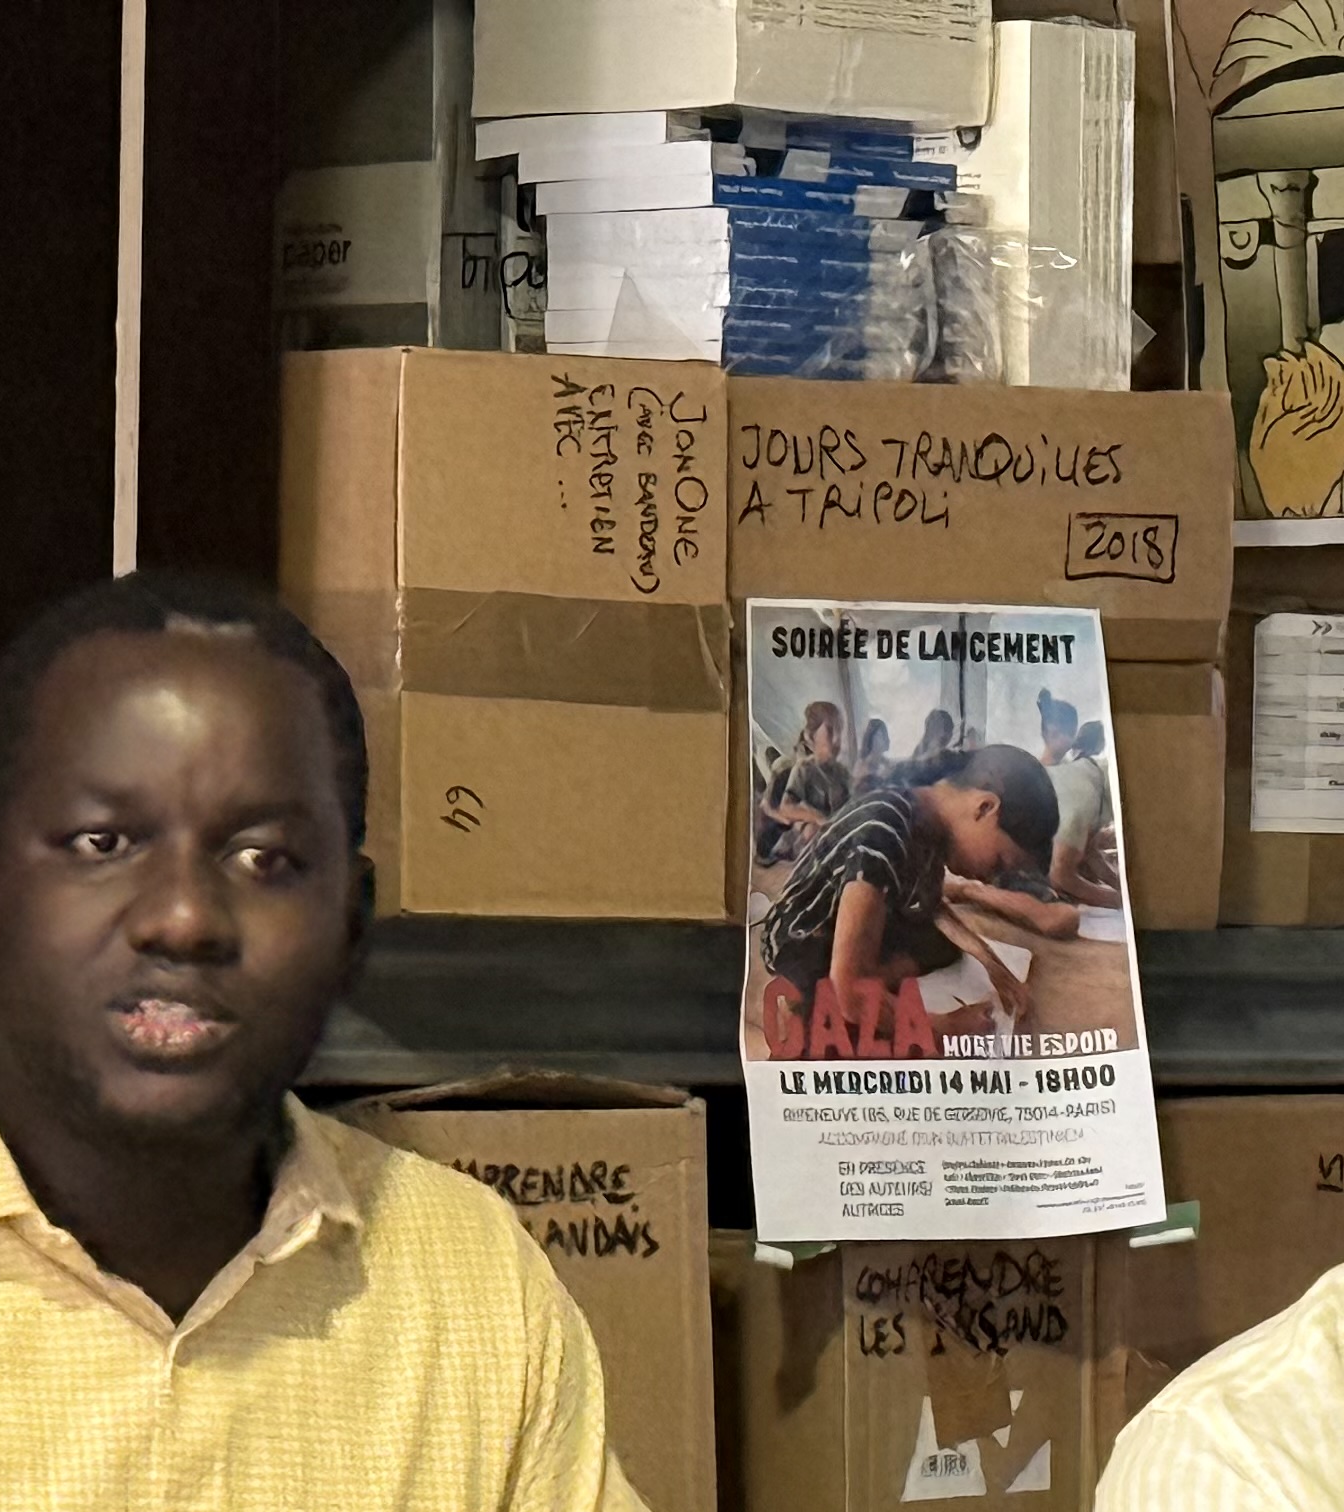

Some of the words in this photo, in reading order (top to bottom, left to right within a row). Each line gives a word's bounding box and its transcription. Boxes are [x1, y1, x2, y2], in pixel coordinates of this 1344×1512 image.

[741, 424, 866, 480] JOURS
[1083, 521, 1164, 569] 2018
[772, 618, 868, 660] SOIRÉE
[877, 628, 911, 660] DE
[918, 627, 1075, 664] LANCEMENT
[762, 975, 940, 1059] GAZA
[943, 1034, 994, 1057] MORT
[1000, 1033, 1033, 1056] VIE
[1039, 1028, 1119, 1056] ESPOIR
[780, 1070, 805, 1094] LE
[813, 1070, 932, 1094] MERCREDI
[939, 1070, 964, 1093] 14
[970, 1070, 1012, 1093] MAI
[1035, 1064, 1116, 1092] 18H00
[860, 1312, 905, 1359] LES
